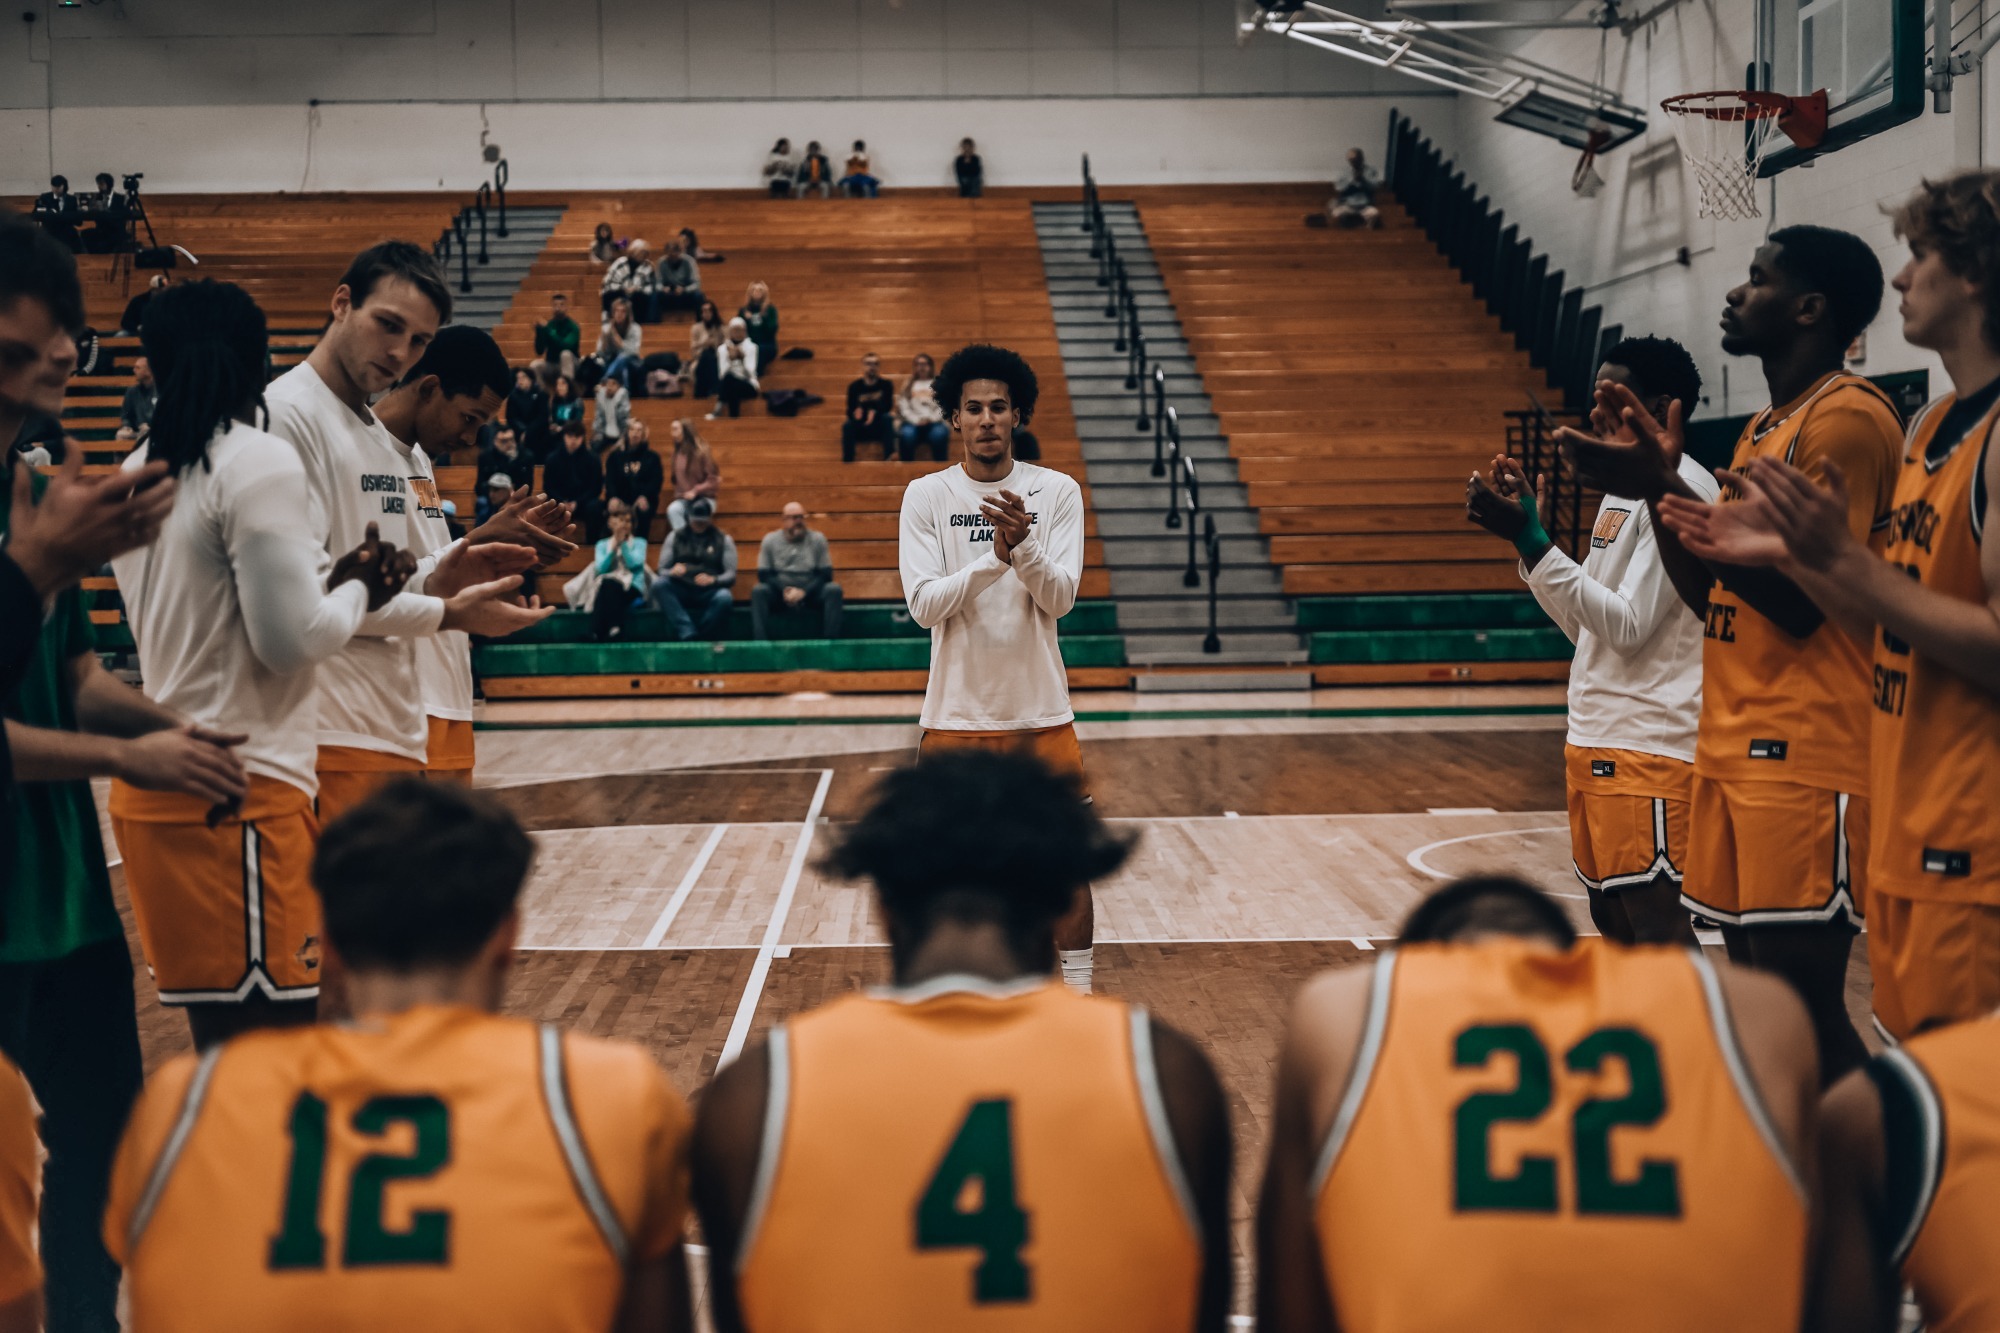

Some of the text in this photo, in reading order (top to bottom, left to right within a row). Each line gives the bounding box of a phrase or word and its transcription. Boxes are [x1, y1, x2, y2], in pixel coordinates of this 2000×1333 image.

[361, 474, 397, 492] OSWEGO
[1604, 765, 1612, 773] XL
[1771, 745, 1781, 754] XL
[1453, 1023, 1683, 1217] 22
[267, 1088, 450, 1271] 12
[912, 1096, 1034, 1305] 4
